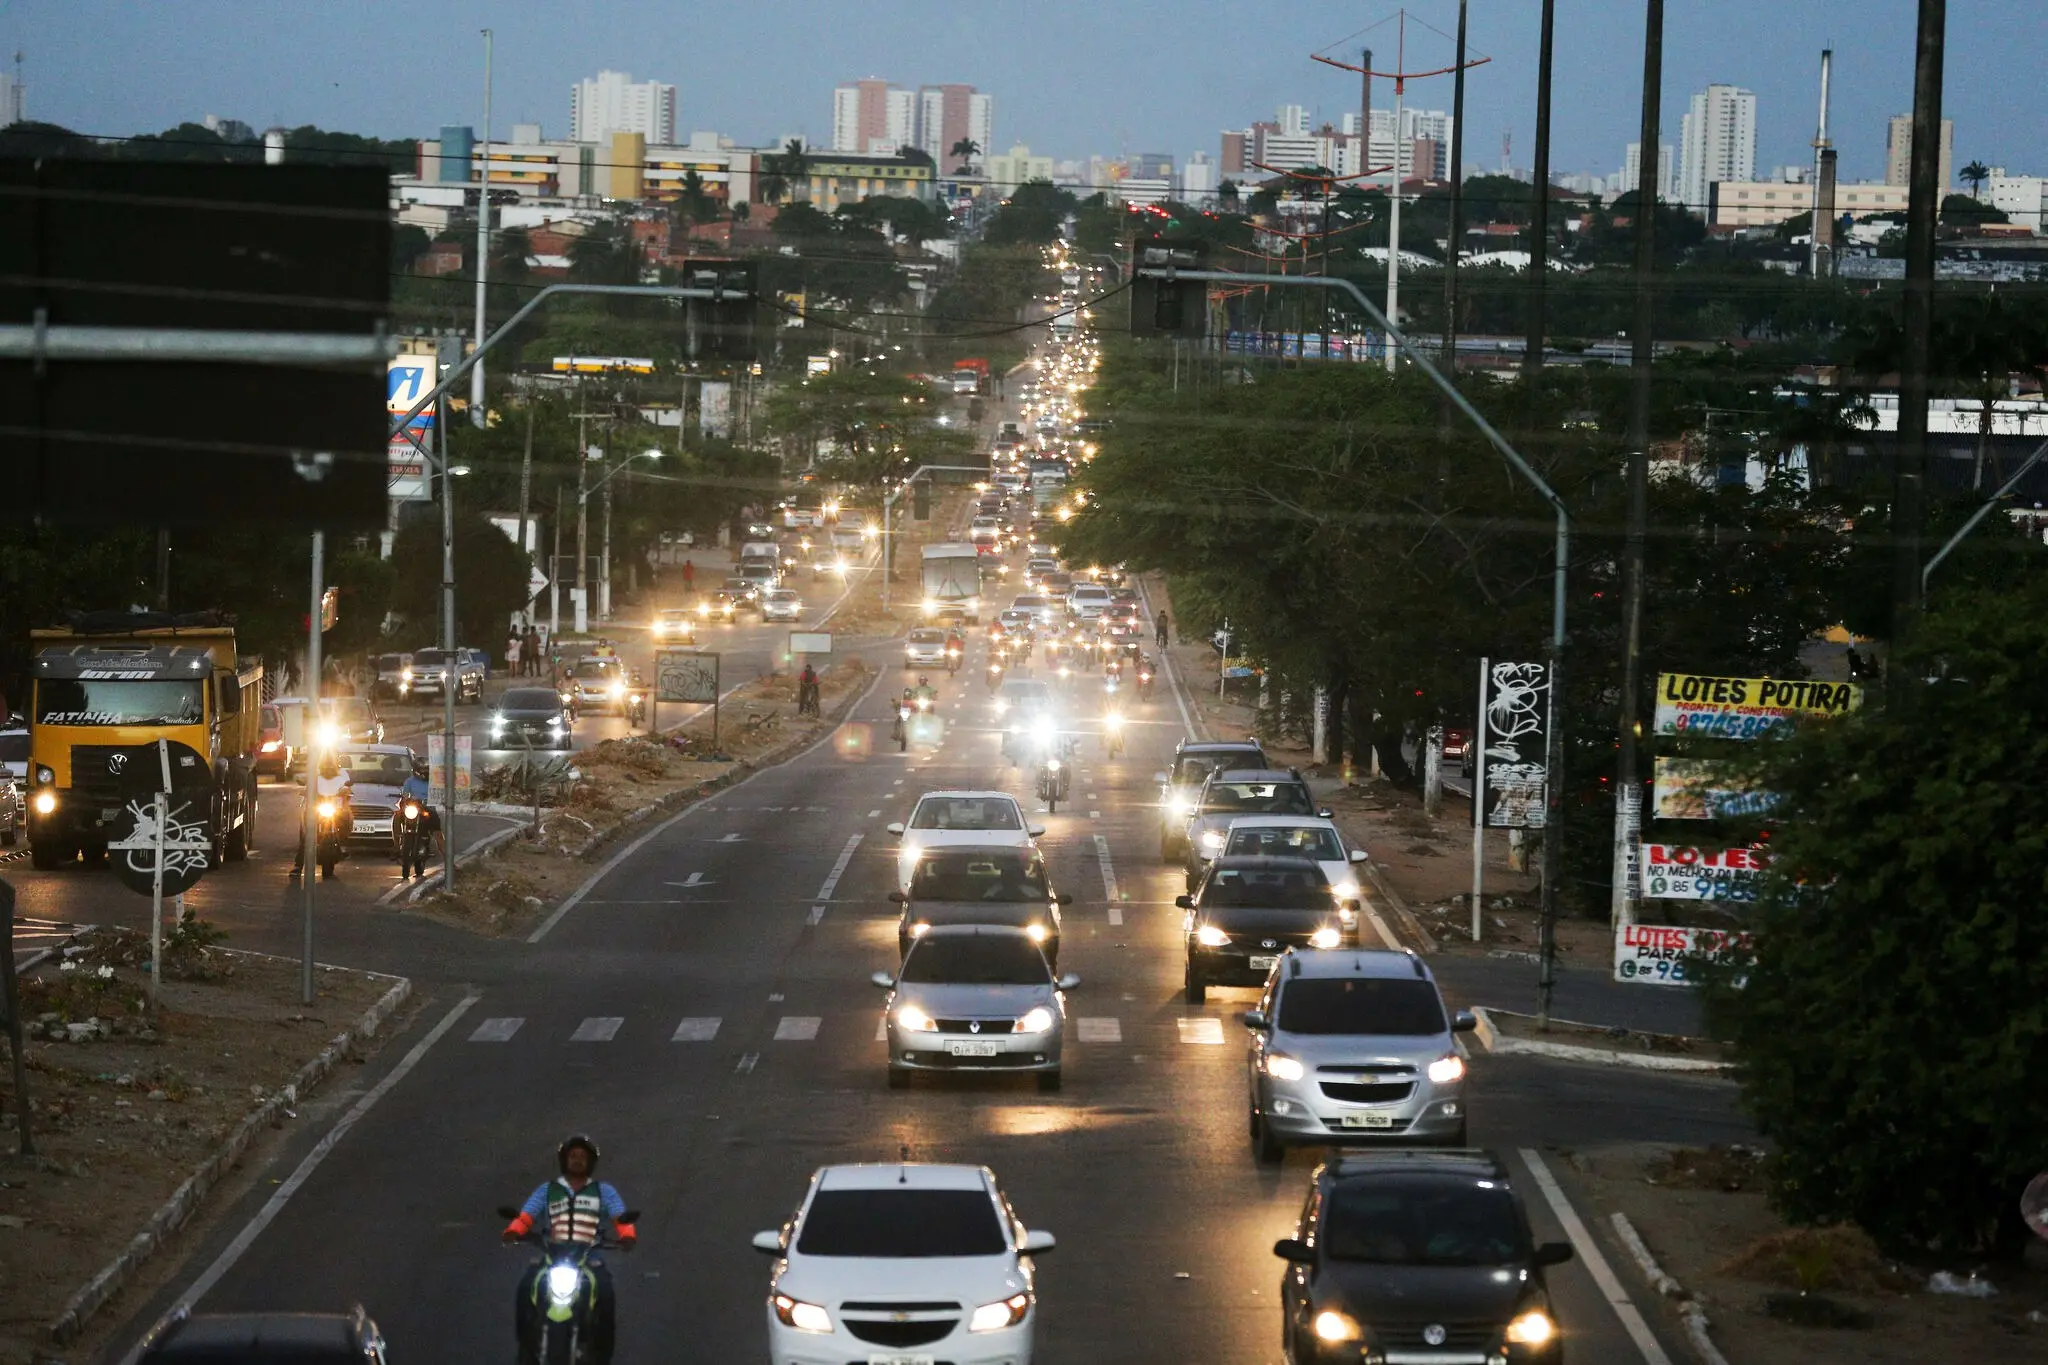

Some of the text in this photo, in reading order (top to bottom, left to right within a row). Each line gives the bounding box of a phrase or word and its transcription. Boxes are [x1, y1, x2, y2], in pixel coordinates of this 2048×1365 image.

[1666, 675, 1850, 711] LOTES POTIRA
[42, 712, 122, 724] FATINHA
[1647, 866, 1665, 878] NO
[1673, 881, 1689, 892] 85
[1624, 925, 1690, 949] LOTES
